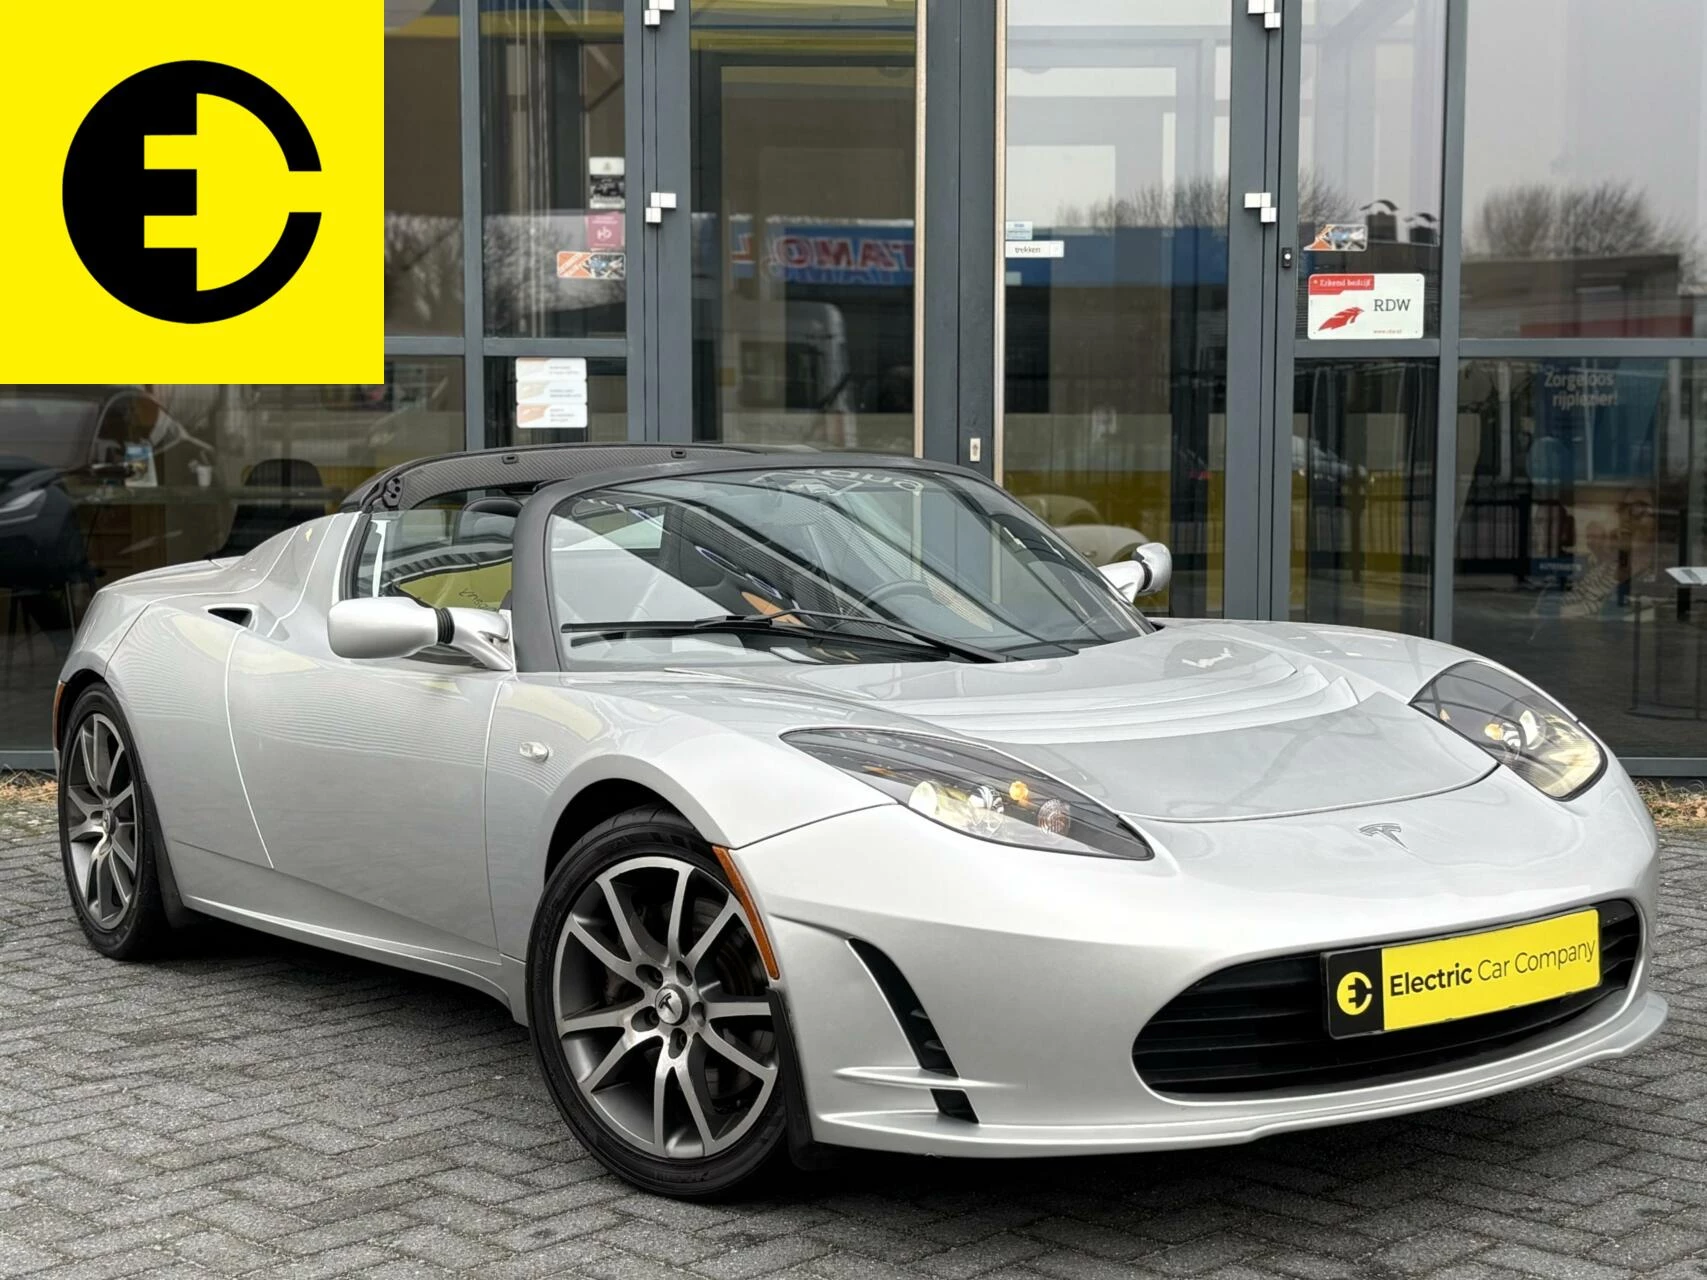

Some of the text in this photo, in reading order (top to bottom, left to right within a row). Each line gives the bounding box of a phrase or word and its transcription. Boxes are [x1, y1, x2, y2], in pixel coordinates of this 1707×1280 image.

[1373, 298, 1411, 312] RDW
[1390, 940, 1596, 997] Electric Car Company
